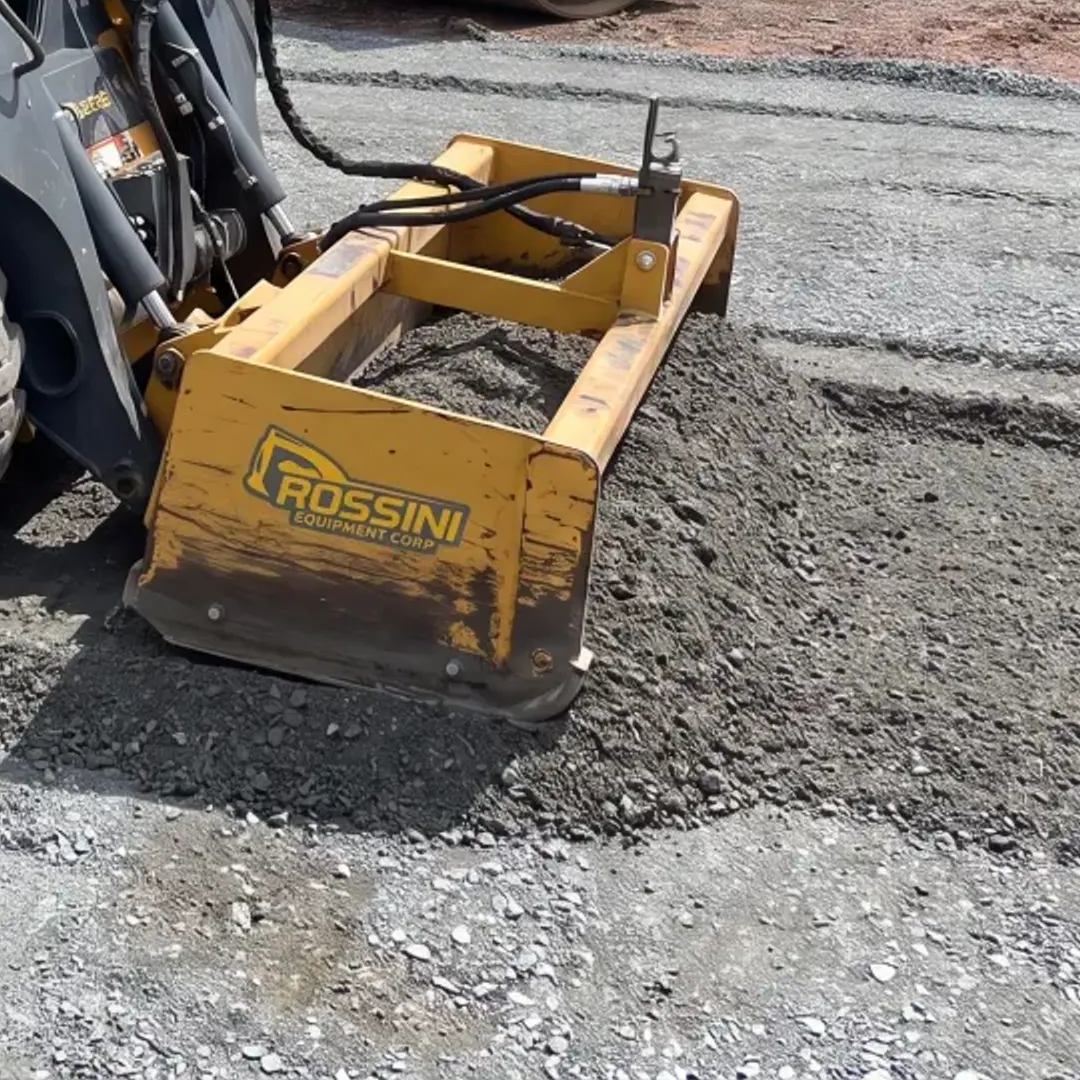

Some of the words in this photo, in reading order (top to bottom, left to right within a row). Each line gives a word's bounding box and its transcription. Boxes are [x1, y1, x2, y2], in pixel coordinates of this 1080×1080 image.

[275, 474, 464, 543] ROSSINI
[294, 512, 387, 540] EQUIPMENT
[389, 531, 436, 550] CORP
